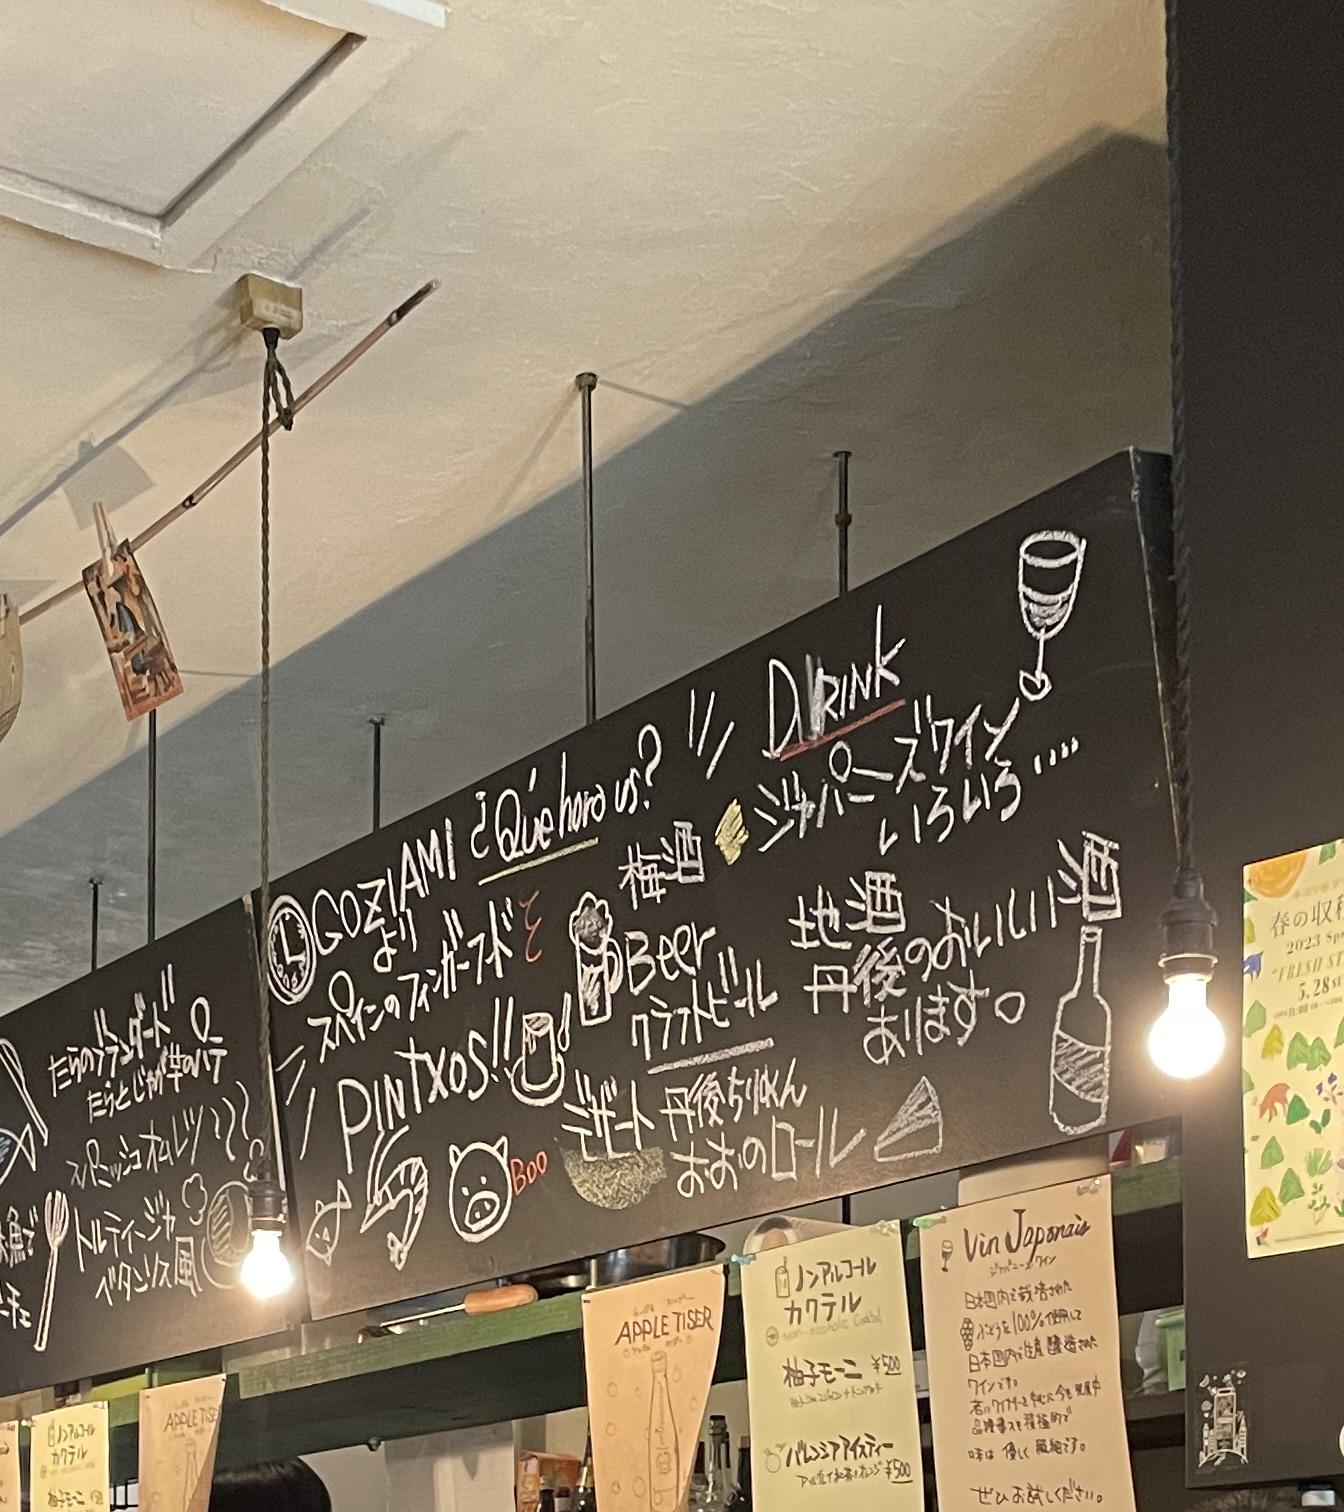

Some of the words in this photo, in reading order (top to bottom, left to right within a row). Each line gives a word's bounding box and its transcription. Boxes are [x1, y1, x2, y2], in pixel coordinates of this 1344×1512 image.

[618, 819, 705, 910] 梅酒
[788, 870, 906, 950] 地酒
[625, 921, 716, 996] Beer
[1286, 934, 1320, 956] 2023
[963, 1228, 1000, 1263] Vin
[784, 1291, 862, 1326] カクテル
